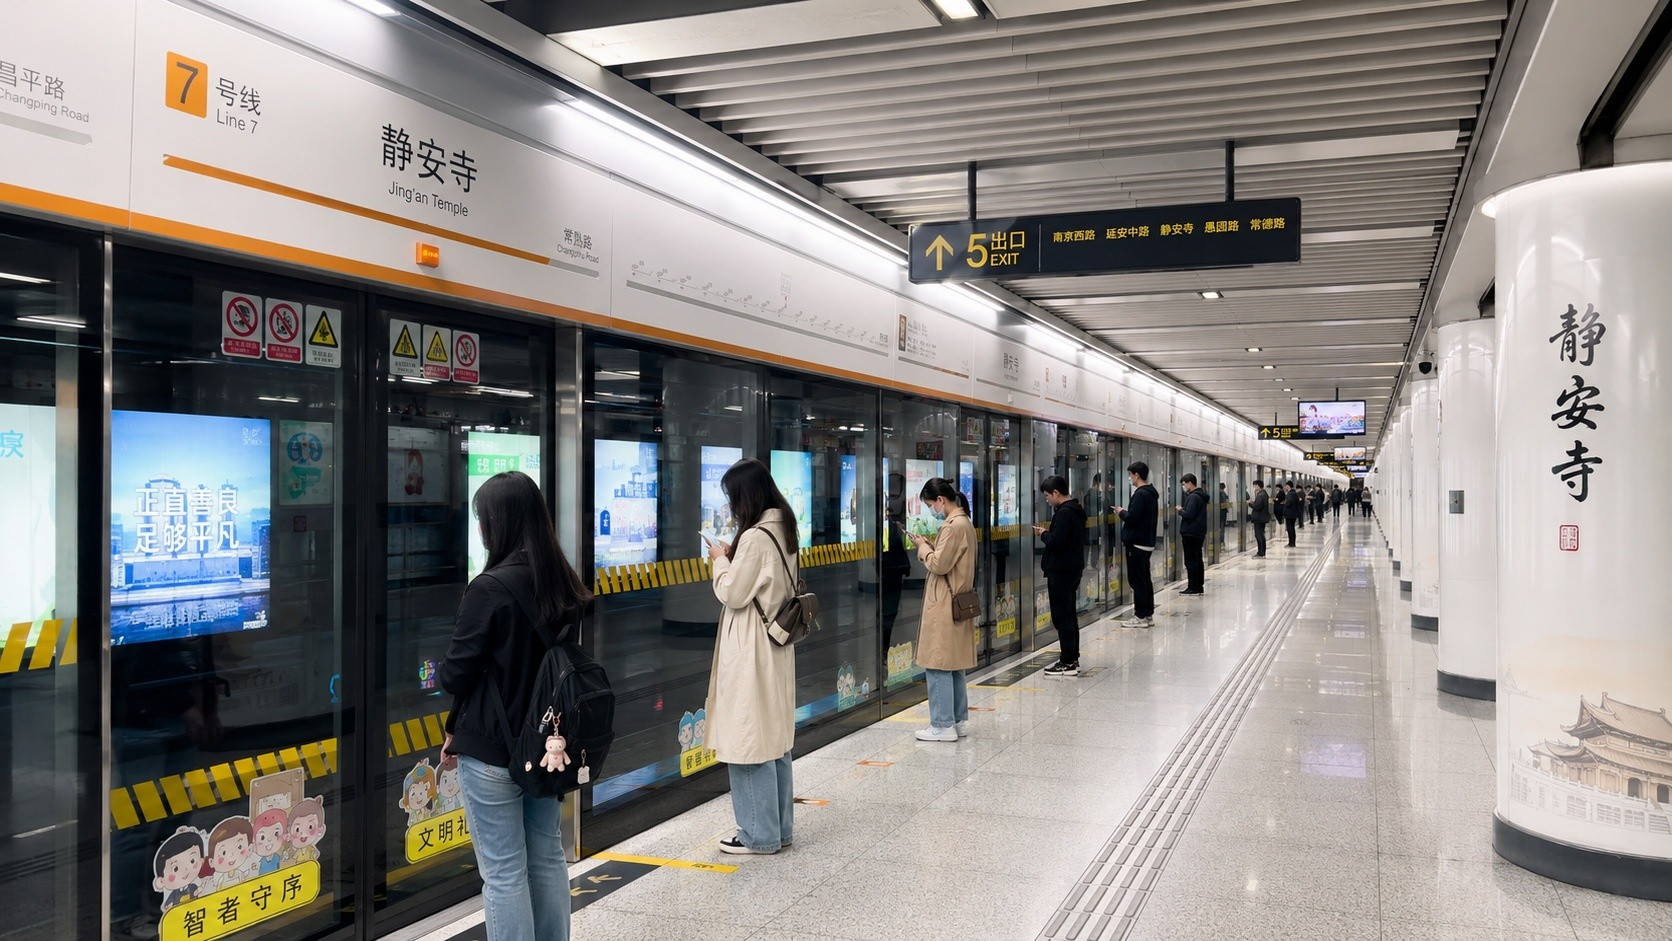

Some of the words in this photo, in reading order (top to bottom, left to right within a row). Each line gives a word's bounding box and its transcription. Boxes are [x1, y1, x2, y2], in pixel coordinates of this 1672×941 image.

[0, 60, 65, 101] 昌平路
[176, 61, 199, 104] 7
[215, 77, 261, 116] 号线
[0, 86, 57, 116] Changping
[61, 105, 90, 122] Road
[216, 108, 246, 131] Line
[250, 119, 258, 134] 7
[381, 123, 478, 193] 静安寺
[388, 181, 429, 205] Jing'an
[431, 193, 469, 217] Temple
[966, 232, 988, 268] 5
[991, 230, 1025, 250] 出口
[1052, 229, 1096, 243] 南京西路
[1105, 225, 1150, 239] 延安中路
[990, 252, 1020, 267] EXIT
[1549, 303, 1607, 503] 静安寺
[134, 487, 239, 516] 正直善良
[134, 520, 240, 553] 足够平凡
[418, 816, 469, 852] 文明礼
[183, 874, 302, 938] 智者守序
